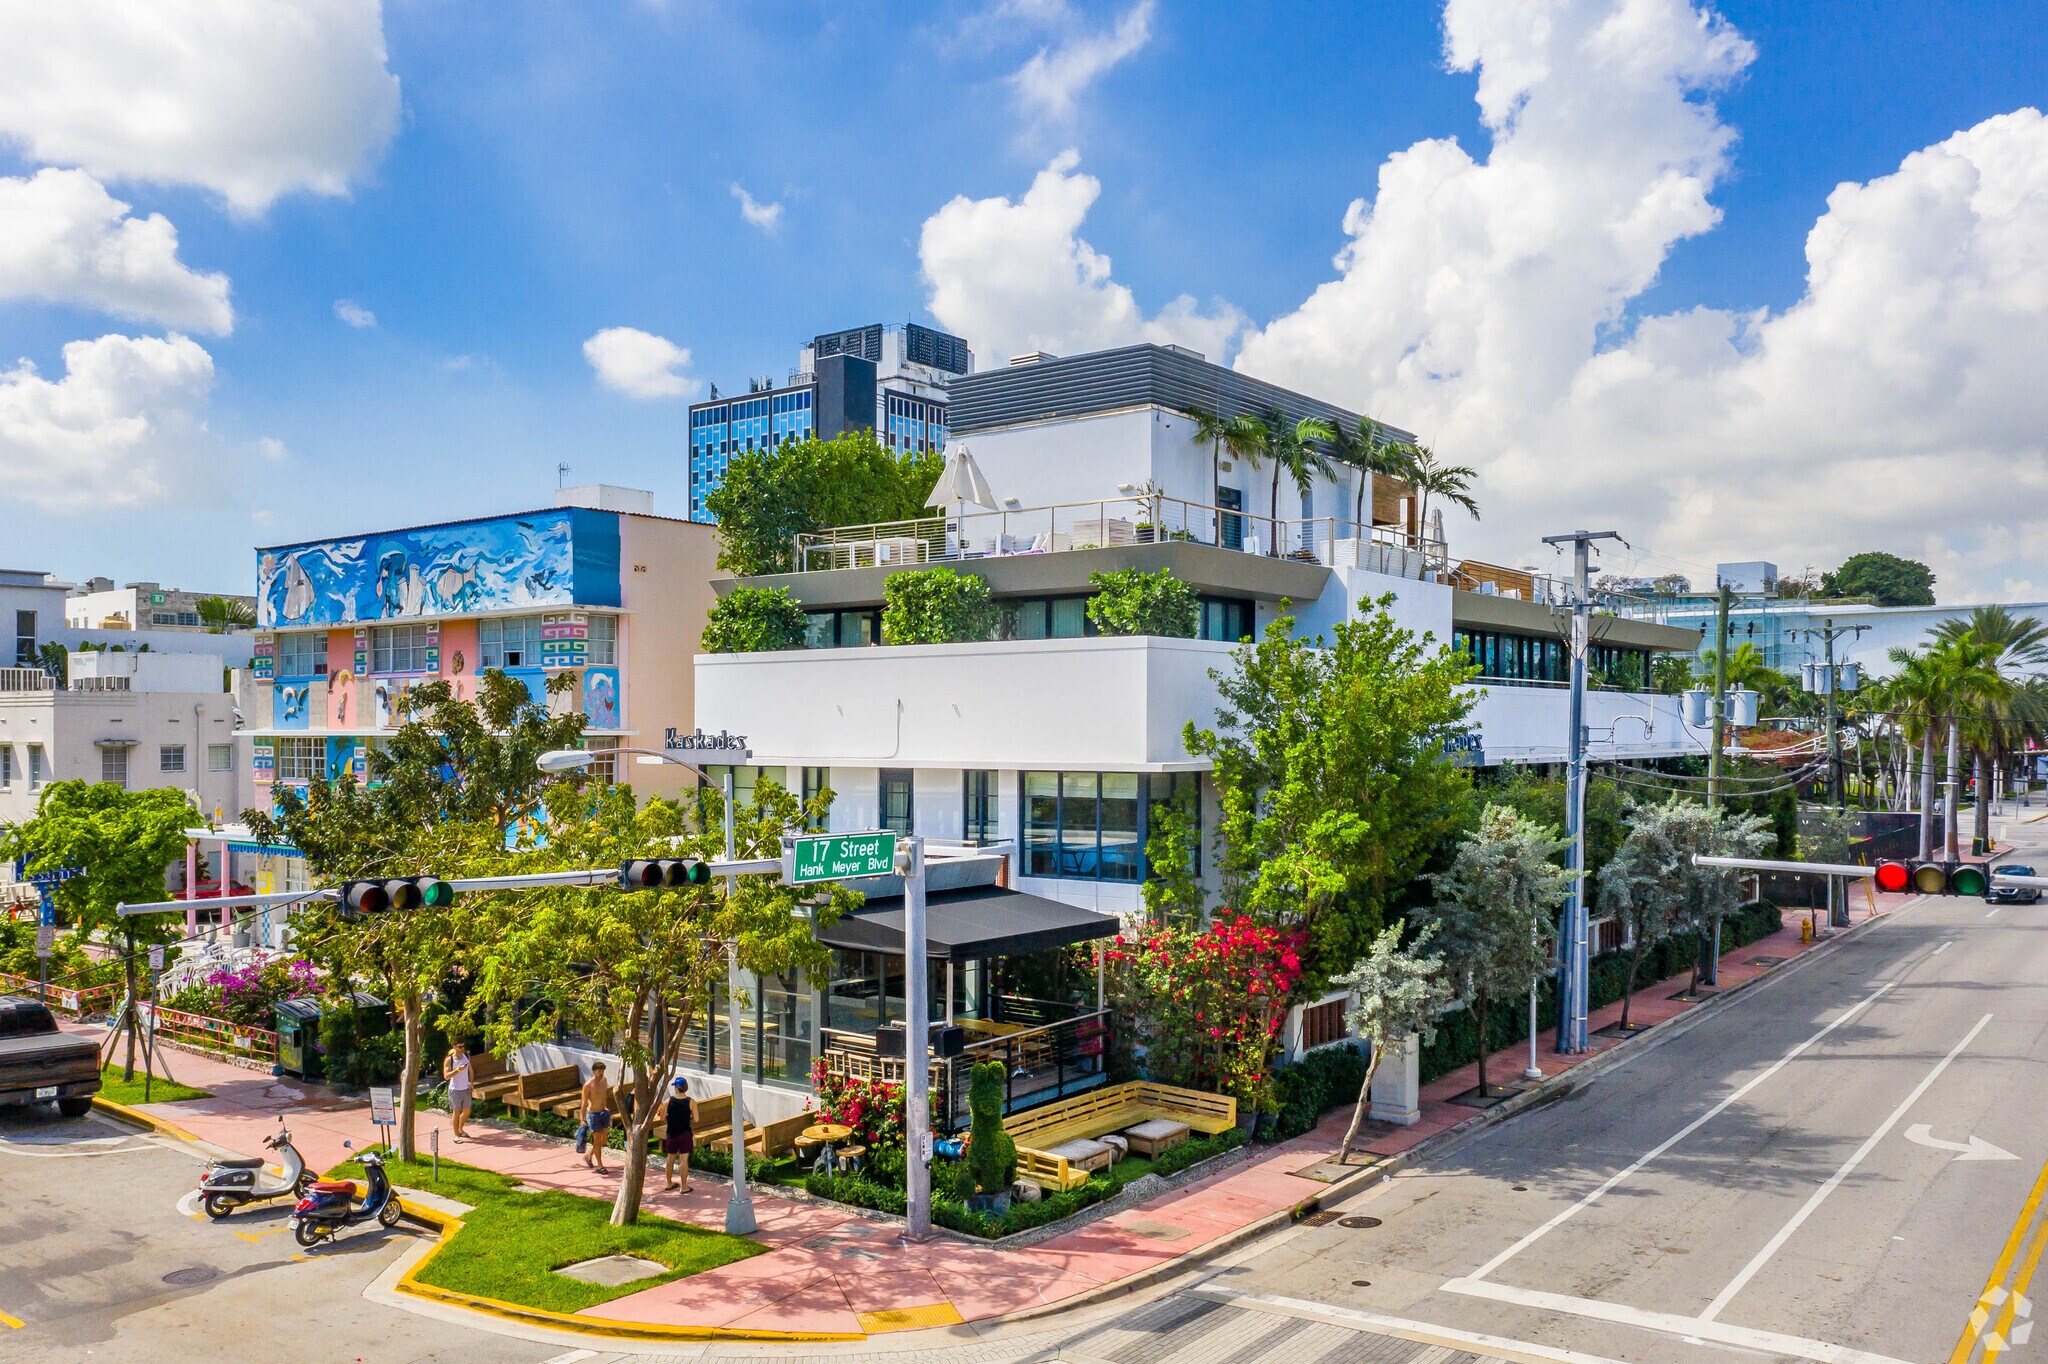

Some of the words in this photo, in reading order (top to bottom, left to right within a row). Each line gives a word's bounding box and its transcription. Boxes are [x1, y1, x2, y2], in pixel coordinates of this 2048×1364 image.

[665, 728, 748, 750] Kaskades
[813, 841, 830, 862] 17
[840, 839, 879, 858] Street
[800, 863, 824, 877] Hank
[832, 861, 861, 875] Meyer
[868, 857, 888, 870] Blvd
